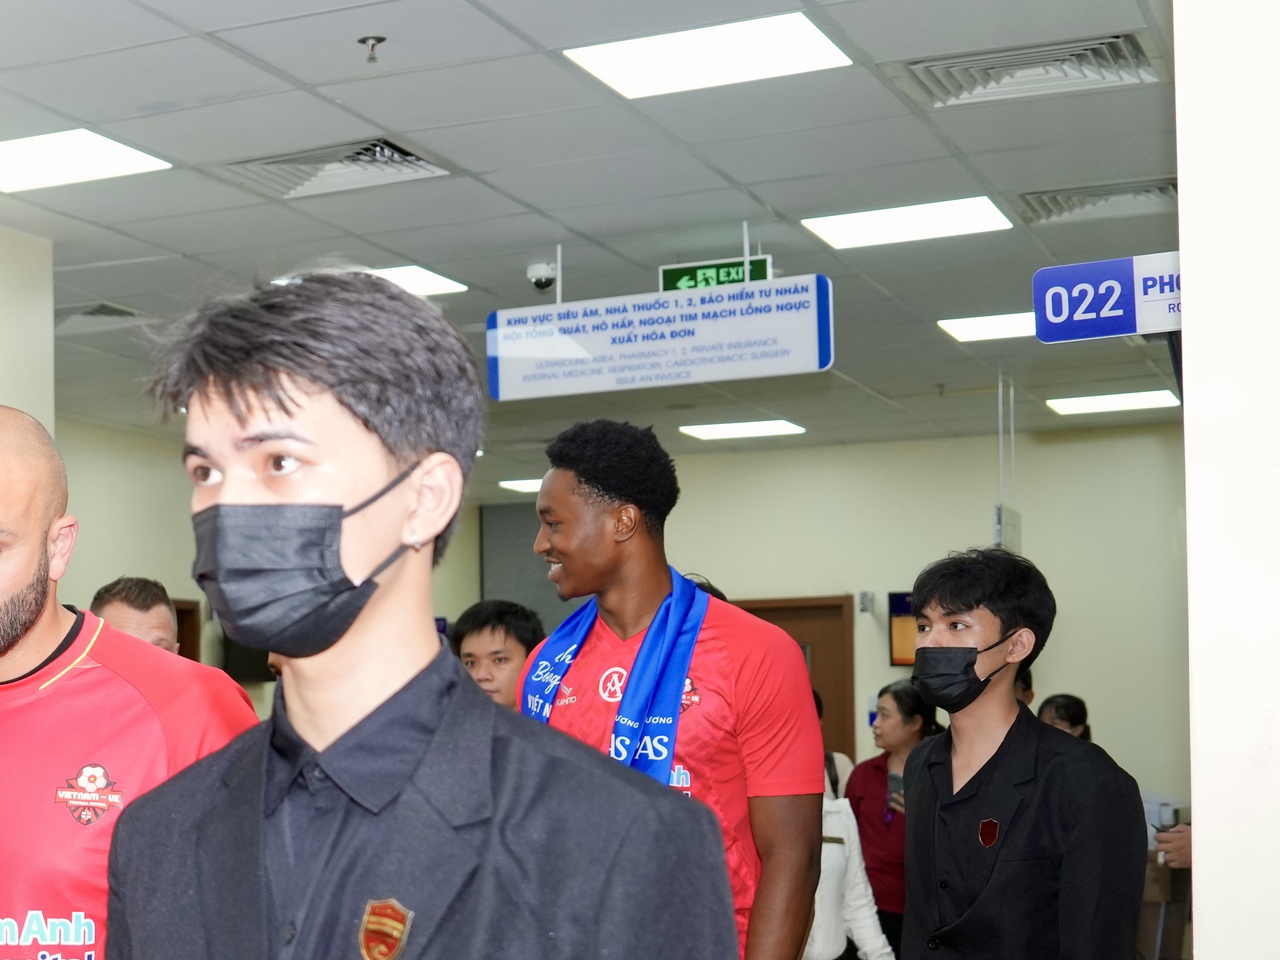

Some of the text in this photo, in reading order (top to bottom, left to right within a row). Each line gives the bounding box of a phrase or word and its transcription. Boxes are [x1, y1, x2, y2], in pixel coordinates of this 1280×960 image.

[507, 317, 528, 326] KHU
[531, 313, 553, 325] VỰC
[557, 309, 578, 321] SIÊU
[605, 301, 629, 315] NHÀ
[632, 297, 670, 313] THUỐC
[700, 292, 724, 305] BẢO
[728, 287, 755, 302] HIỂM
[758, 287, 772, 298] TƯ
[775, 284, 810, 297] NHÂN
[1045, 279, 1124, 324] 022
[639, 315, 677, 328] NGOẠI
[680, 313, 698, 322] TIM
[702, 308, 737, 322] MẠCH
[776, 299, 811, 313] NGỰC
[611, 330, 638, 345] XUẤT
[671, 328, 695, 338] ĐƠN
[527, 694, 543, 715] VIỆT
[615, 715, 640, 728] ƯƠNG
[645, 716, 673, 724] ƯƠNG
[108, 794, 120, 803] UK
[19, 910, 95, 945] Anh
